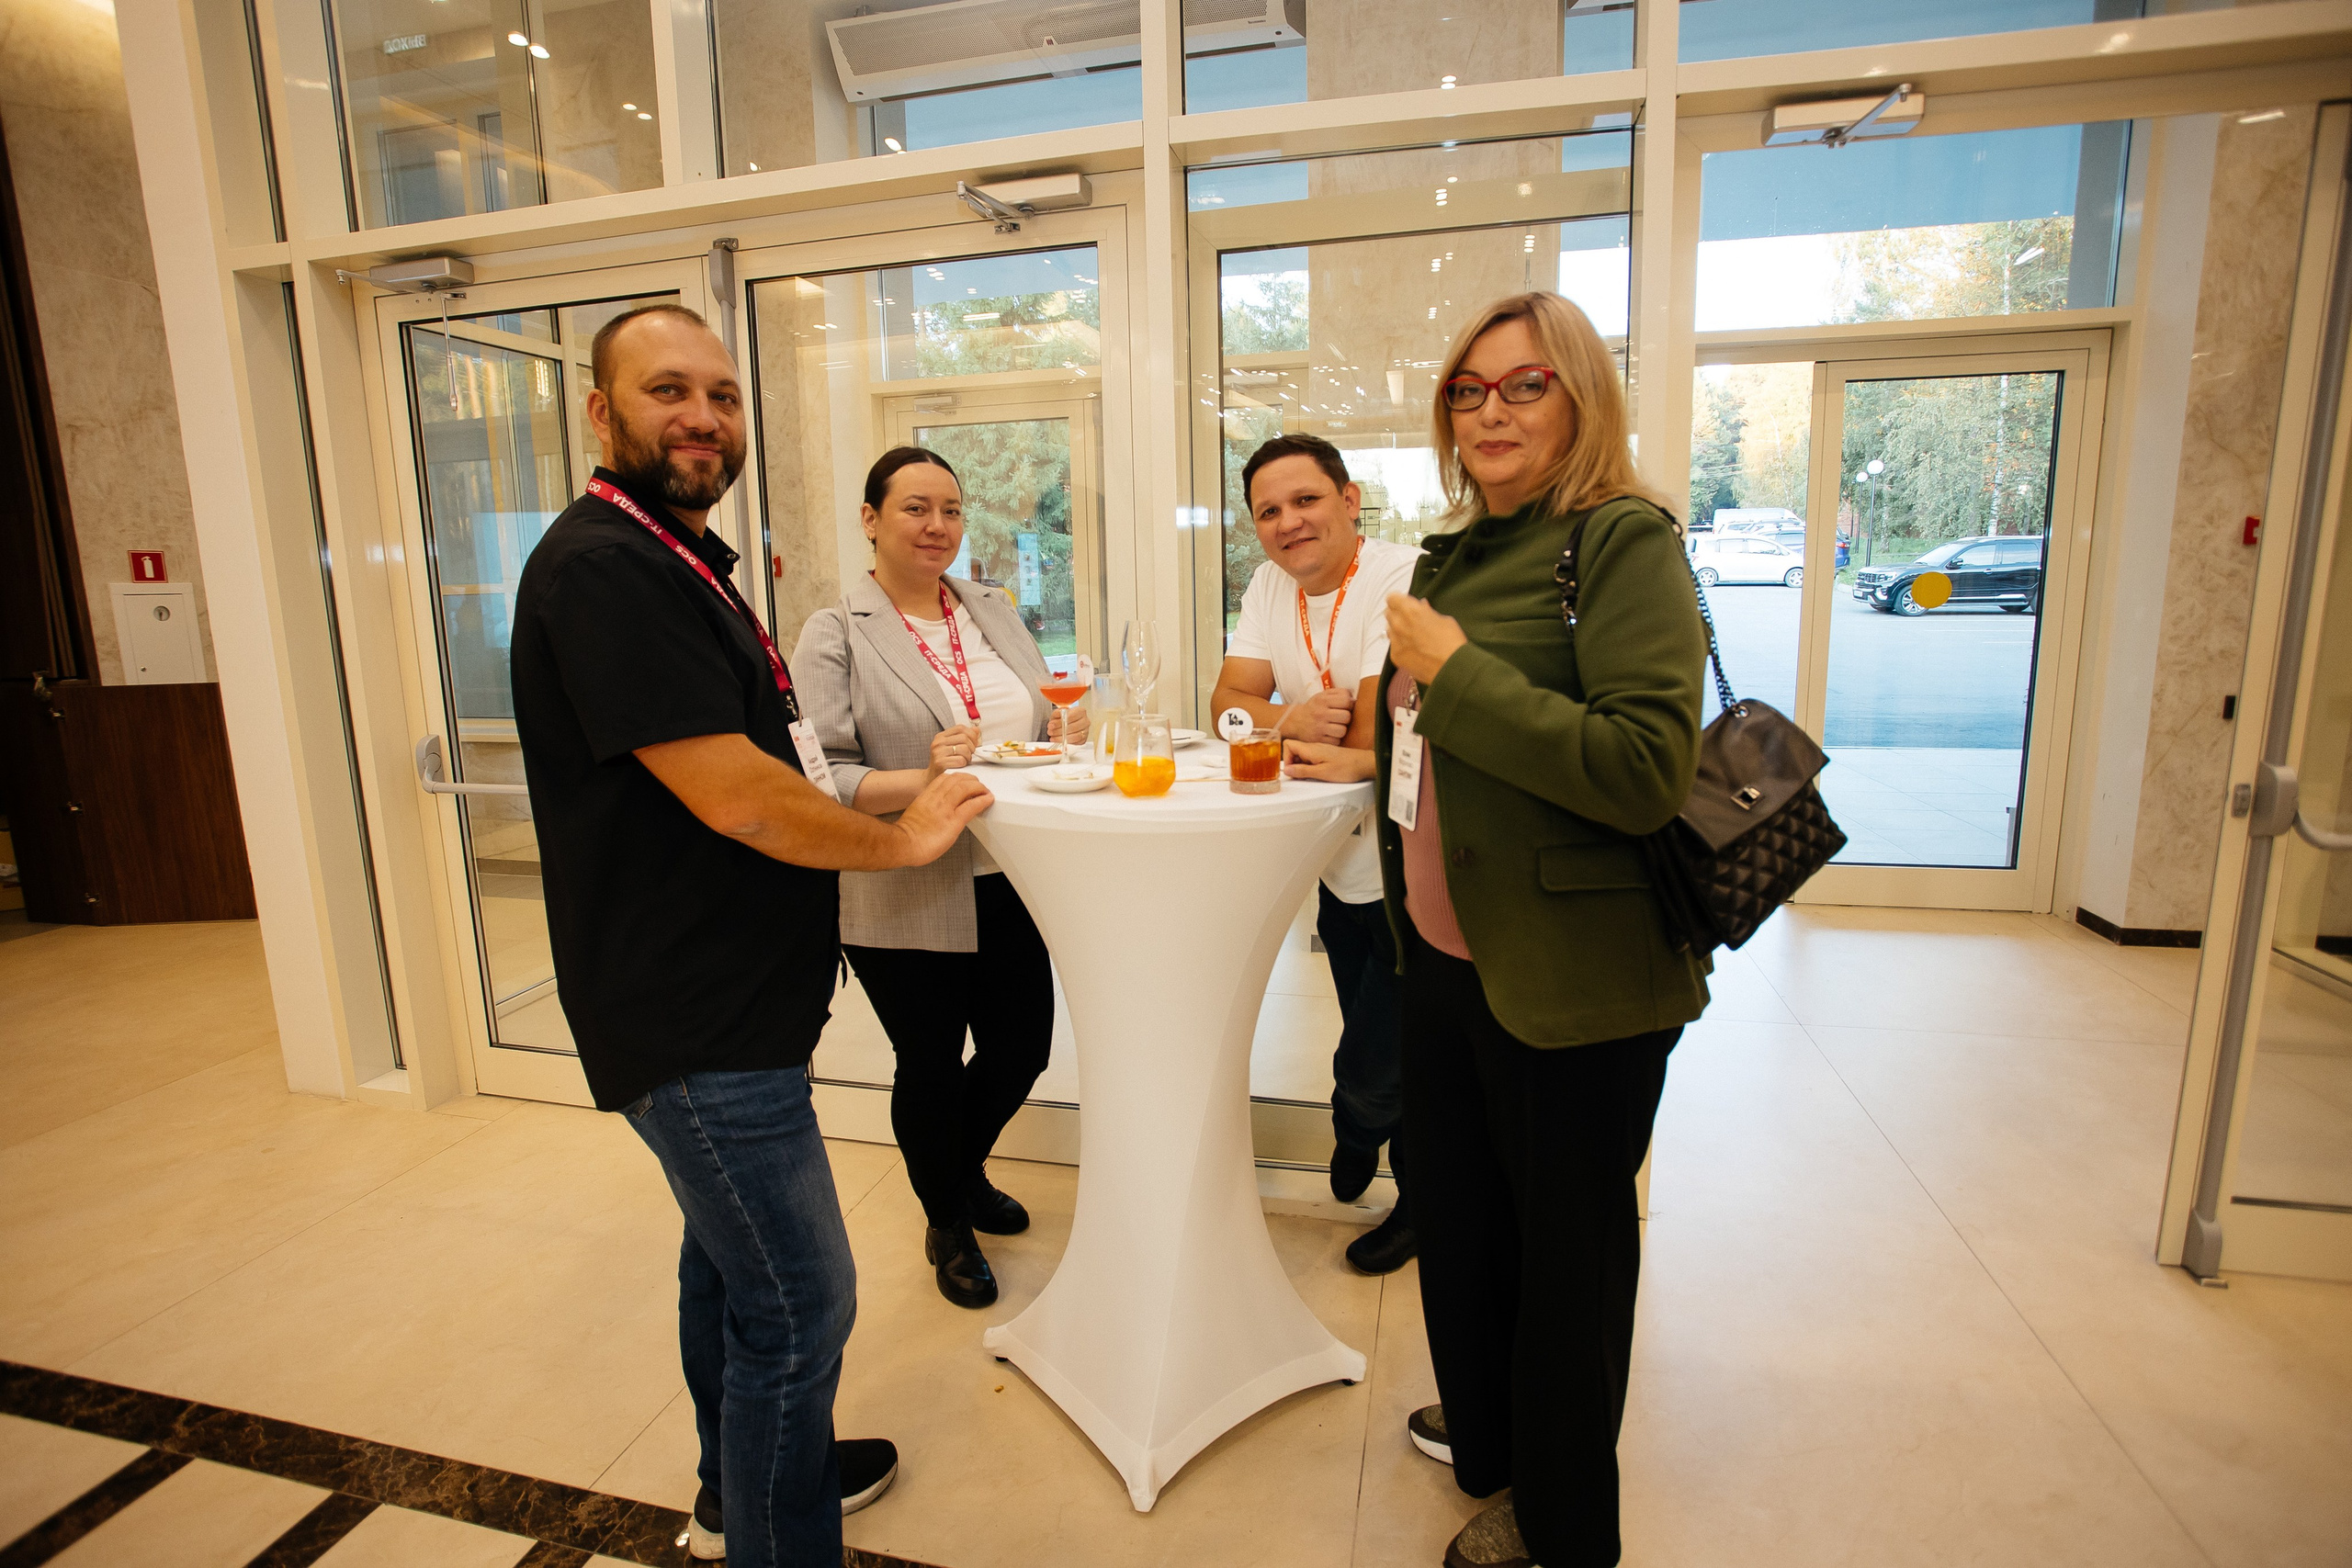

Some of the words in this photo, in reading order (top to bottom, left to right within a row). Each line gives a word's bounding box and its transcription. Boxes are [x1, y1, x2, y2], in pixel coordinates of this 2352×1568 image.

[587, 481, 602, 493] OCS
[612, 492, 662, 535] IT-СРЕДА
[674, 545, 697, 566] OCS
[909, 631, 922, 646] OCS
[923, 649, 952, 680] IT-СРЕДА
